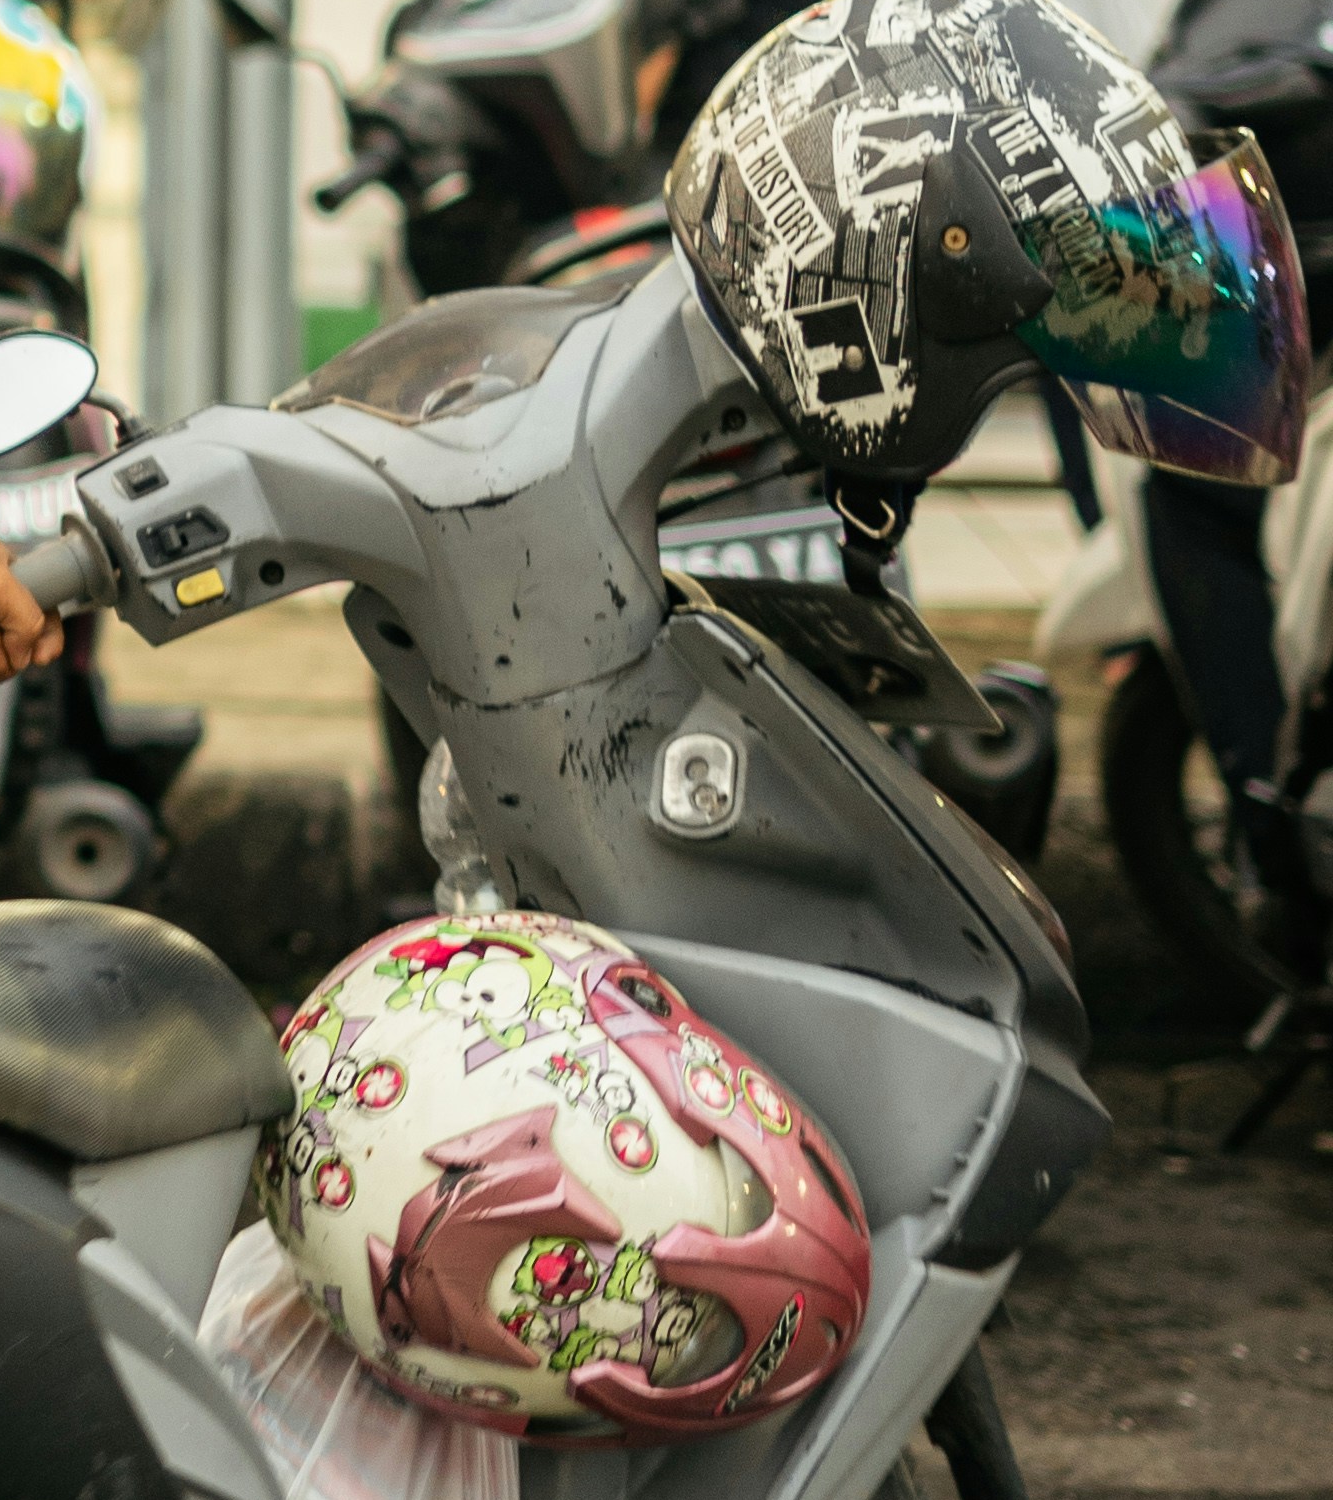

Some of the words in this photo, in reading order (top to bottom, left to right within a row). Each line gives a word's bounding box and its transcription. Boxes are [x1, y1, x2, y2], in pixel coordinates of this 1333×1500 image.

[734, 114, 771, 153] OF
[988, 108, 1048, 168] THE
[1020, 156, 1064, 187] 7
[744, 144, 827, 256] HISTORY
